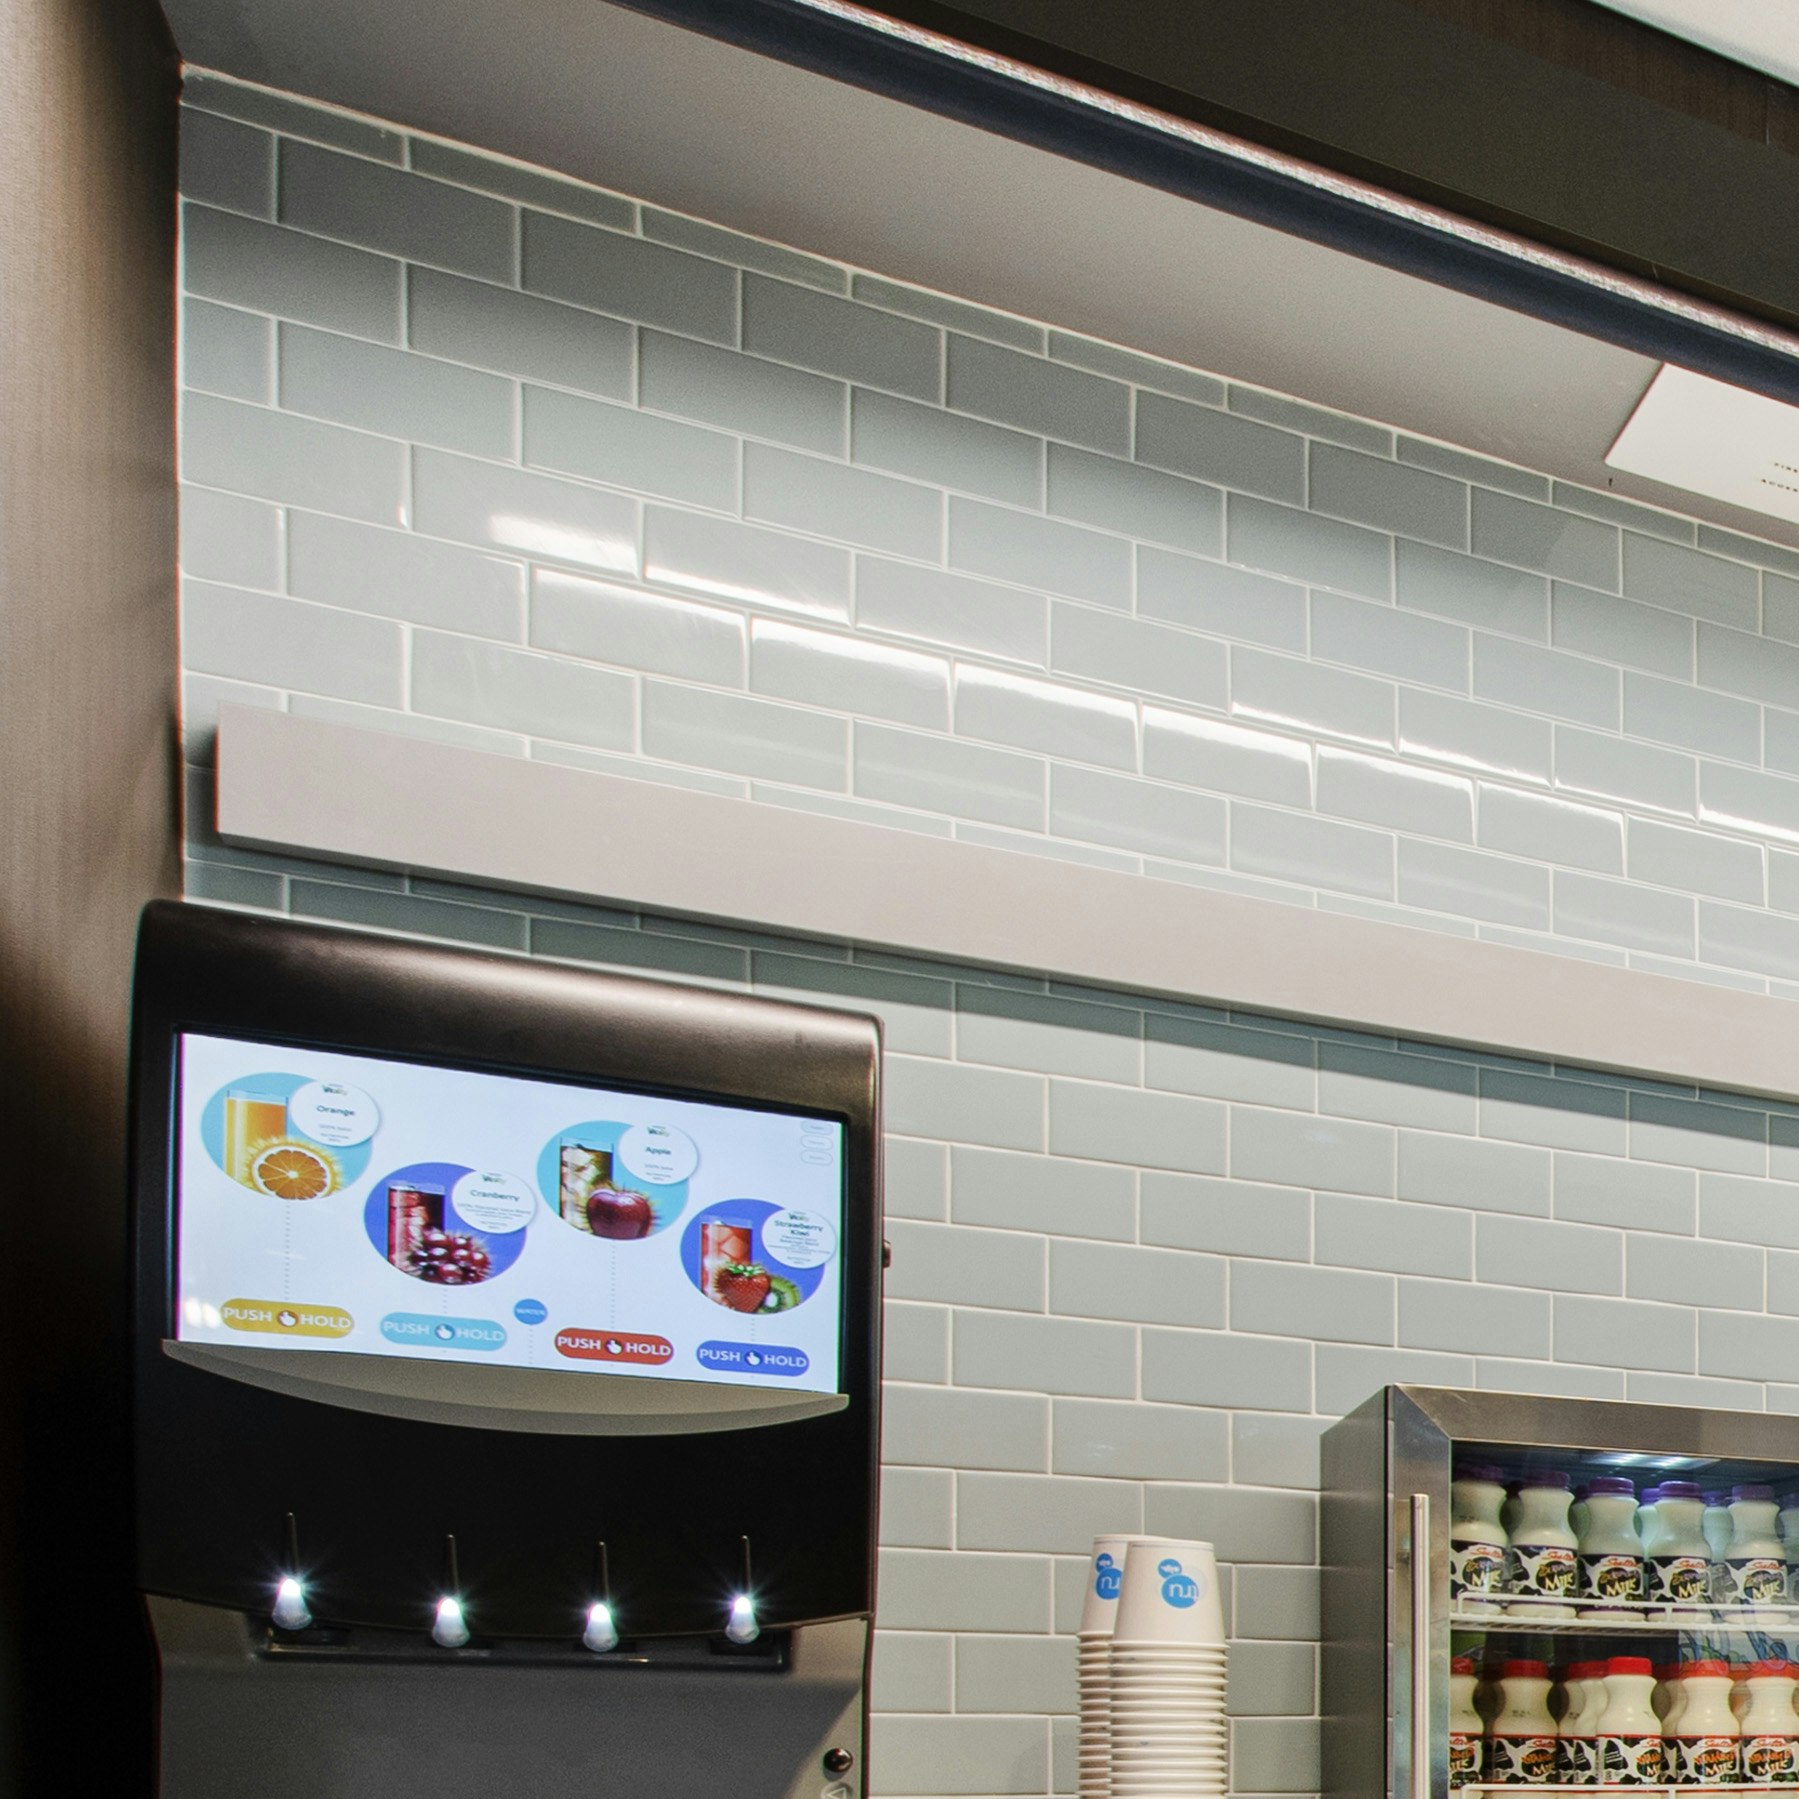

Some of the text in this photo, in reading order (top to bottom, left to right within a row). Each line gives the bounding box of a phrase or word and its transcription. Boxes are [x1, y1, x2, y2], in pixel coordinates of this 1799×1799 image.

[316, 1105, 355, 1116] Orange
[645, 1146, 671, 1155] Apple
[470, 1190, 520, 1202] Cranberry
[223, 1307, 353, 1329] PUSH HOLD
[383, 1320, 506, 1342] PUSH HOLD
[557, 1335, 672, 1357] PUSH HOLD
[699, 1349, 808, 1369] PUSH HOLD
